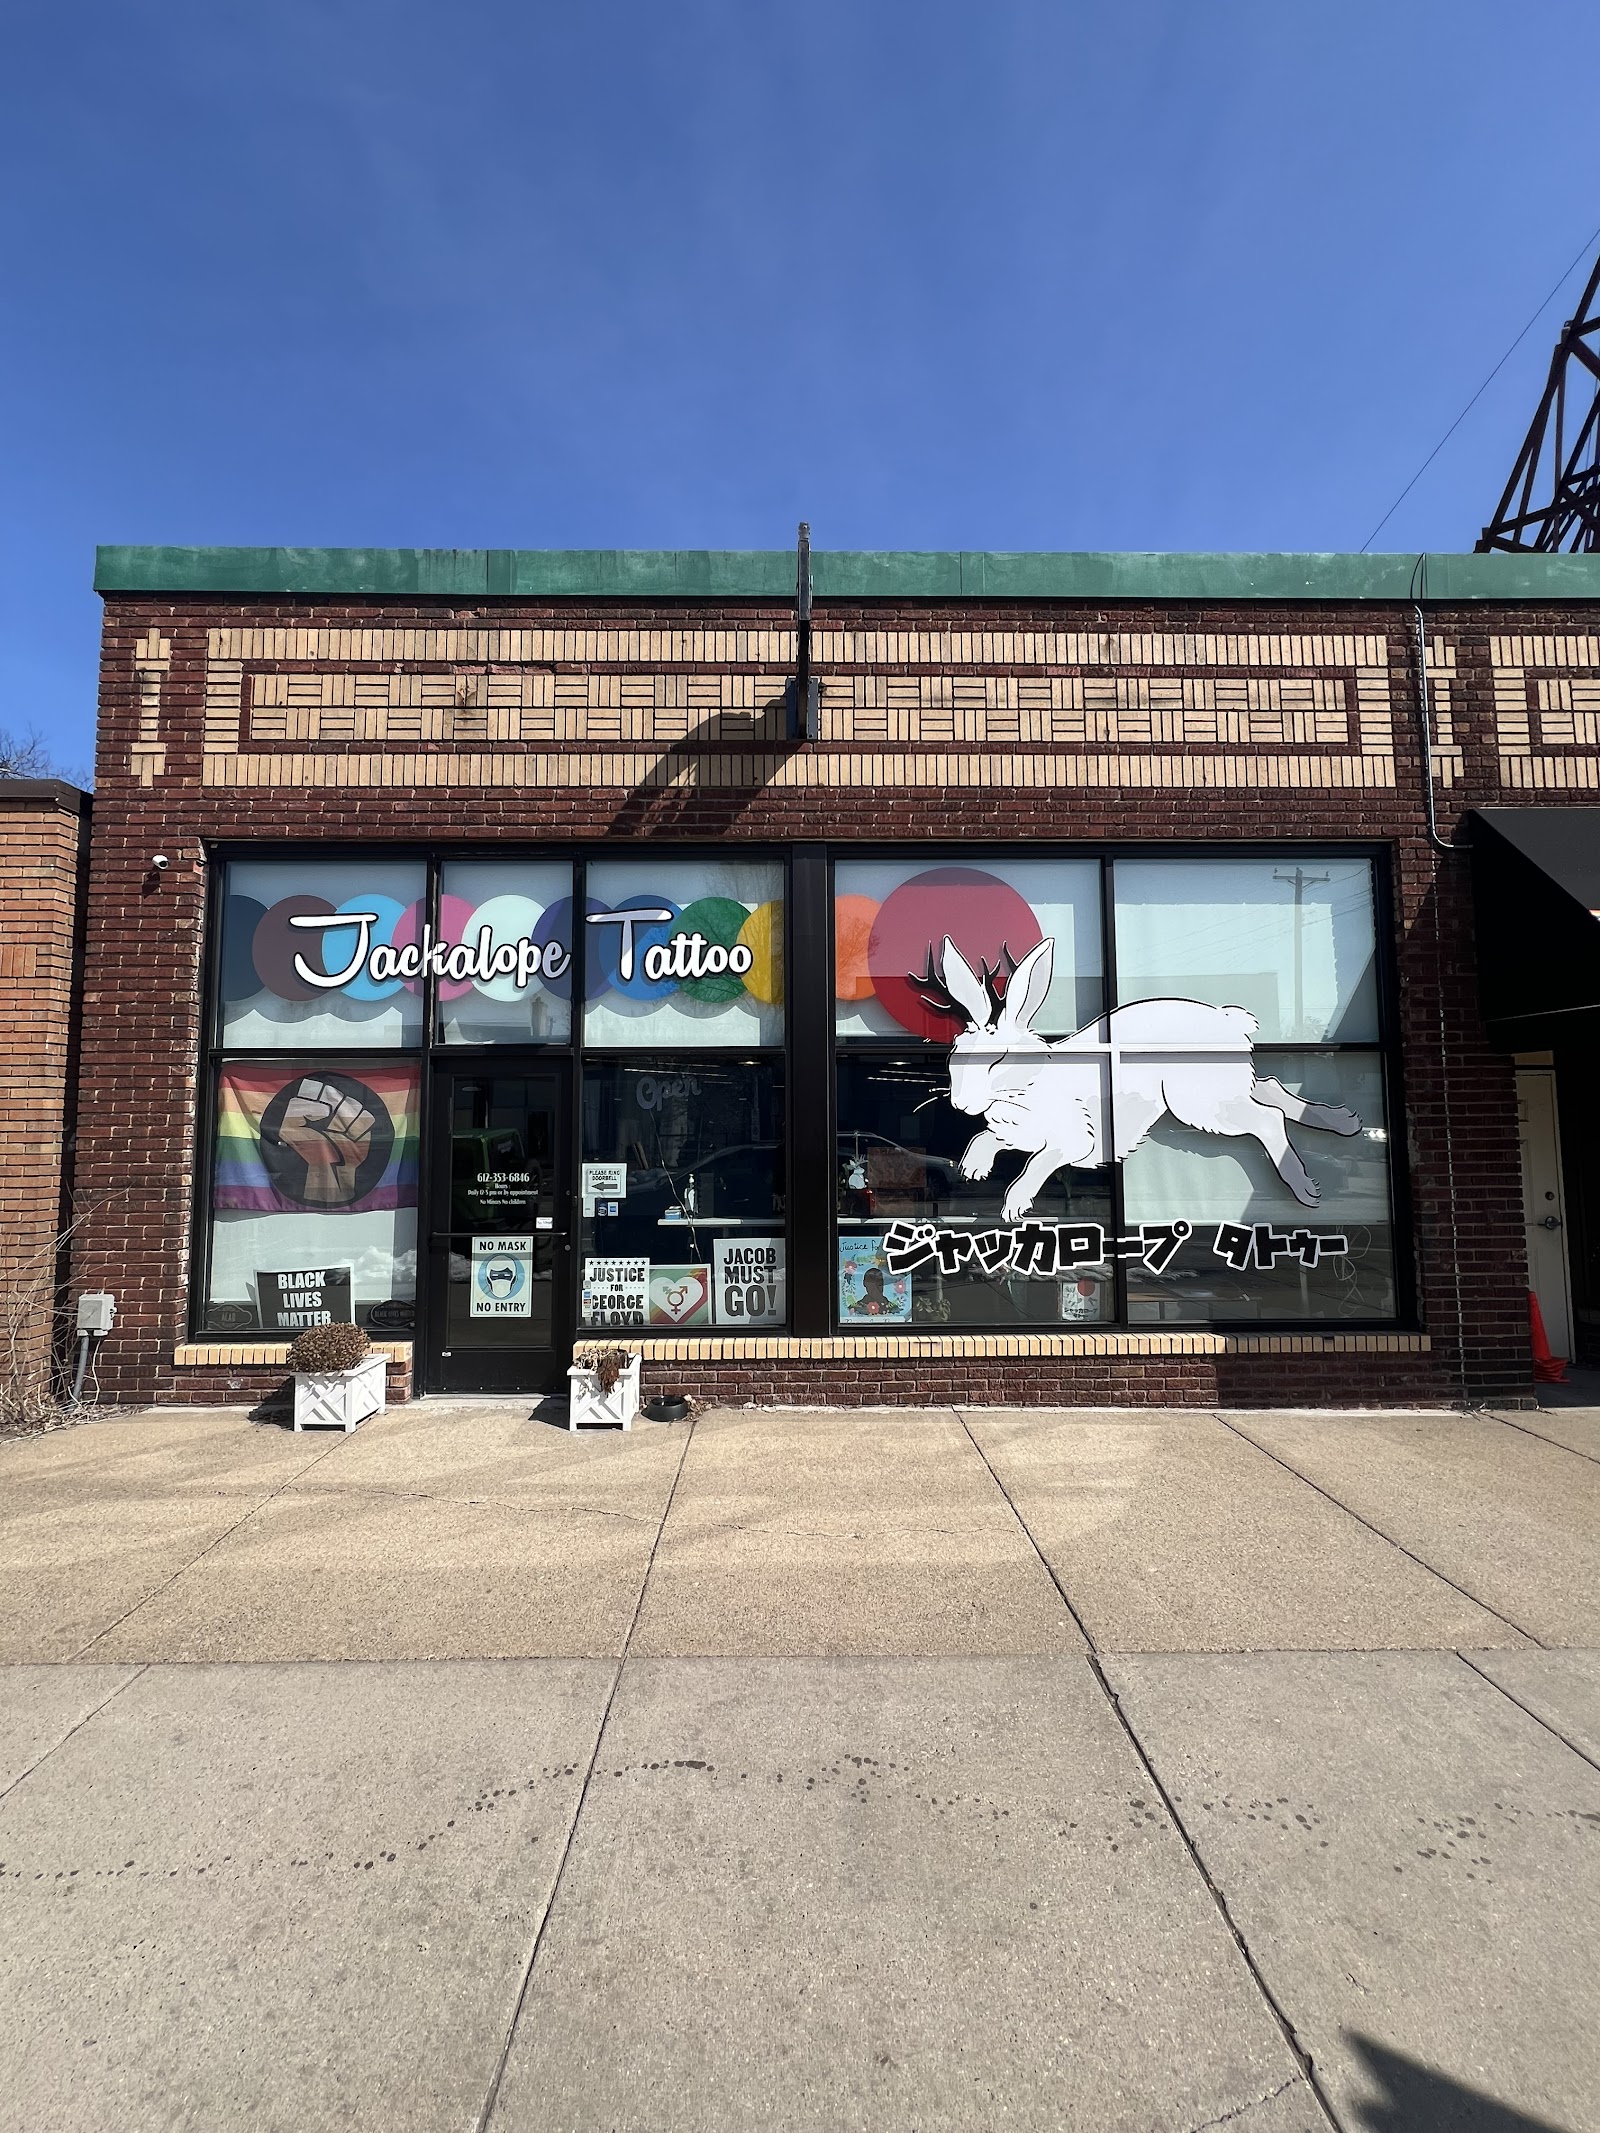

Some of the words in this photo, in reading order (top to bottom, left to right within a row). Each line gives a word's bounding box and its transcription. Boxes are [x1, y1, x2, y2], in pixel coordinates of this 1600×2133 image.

[290, 909, 572, 988] Jackalope
[586, 909, 754, 981] Tattoo
[636, 1074, 702, 1111] Open
[477, 1172, 530, 1182] 612-353-6846
[479, 1241, 494, 1250] NO
[497, 1241, 527, 1250] MASK
[840, 1241, 868, 1252] Justice
[883, 1220, 1193, 1275] ジャッカロープ
[1213, 1220, 1349, 1272] タトゥー
[723, 1247, 776, 1265] JACOB
[277, 1271, 326, 1289] BLACK
[589, 1267, 645, 1283] JUSTICE
[724, 1266, 776, 1284] MUST
[282, 1291, 322, 1308] LIVES
[476, 1302, 491, 1312] NO
[495, 1302, 526, 1312] ENTRY
[592, 1294, 644, 1309] GEORGE
[724, 1285, 777, 1317] GO!
[277, 1311, 331, 1327] MATTER
[591, 1311, 644, 1325] FLOYD
